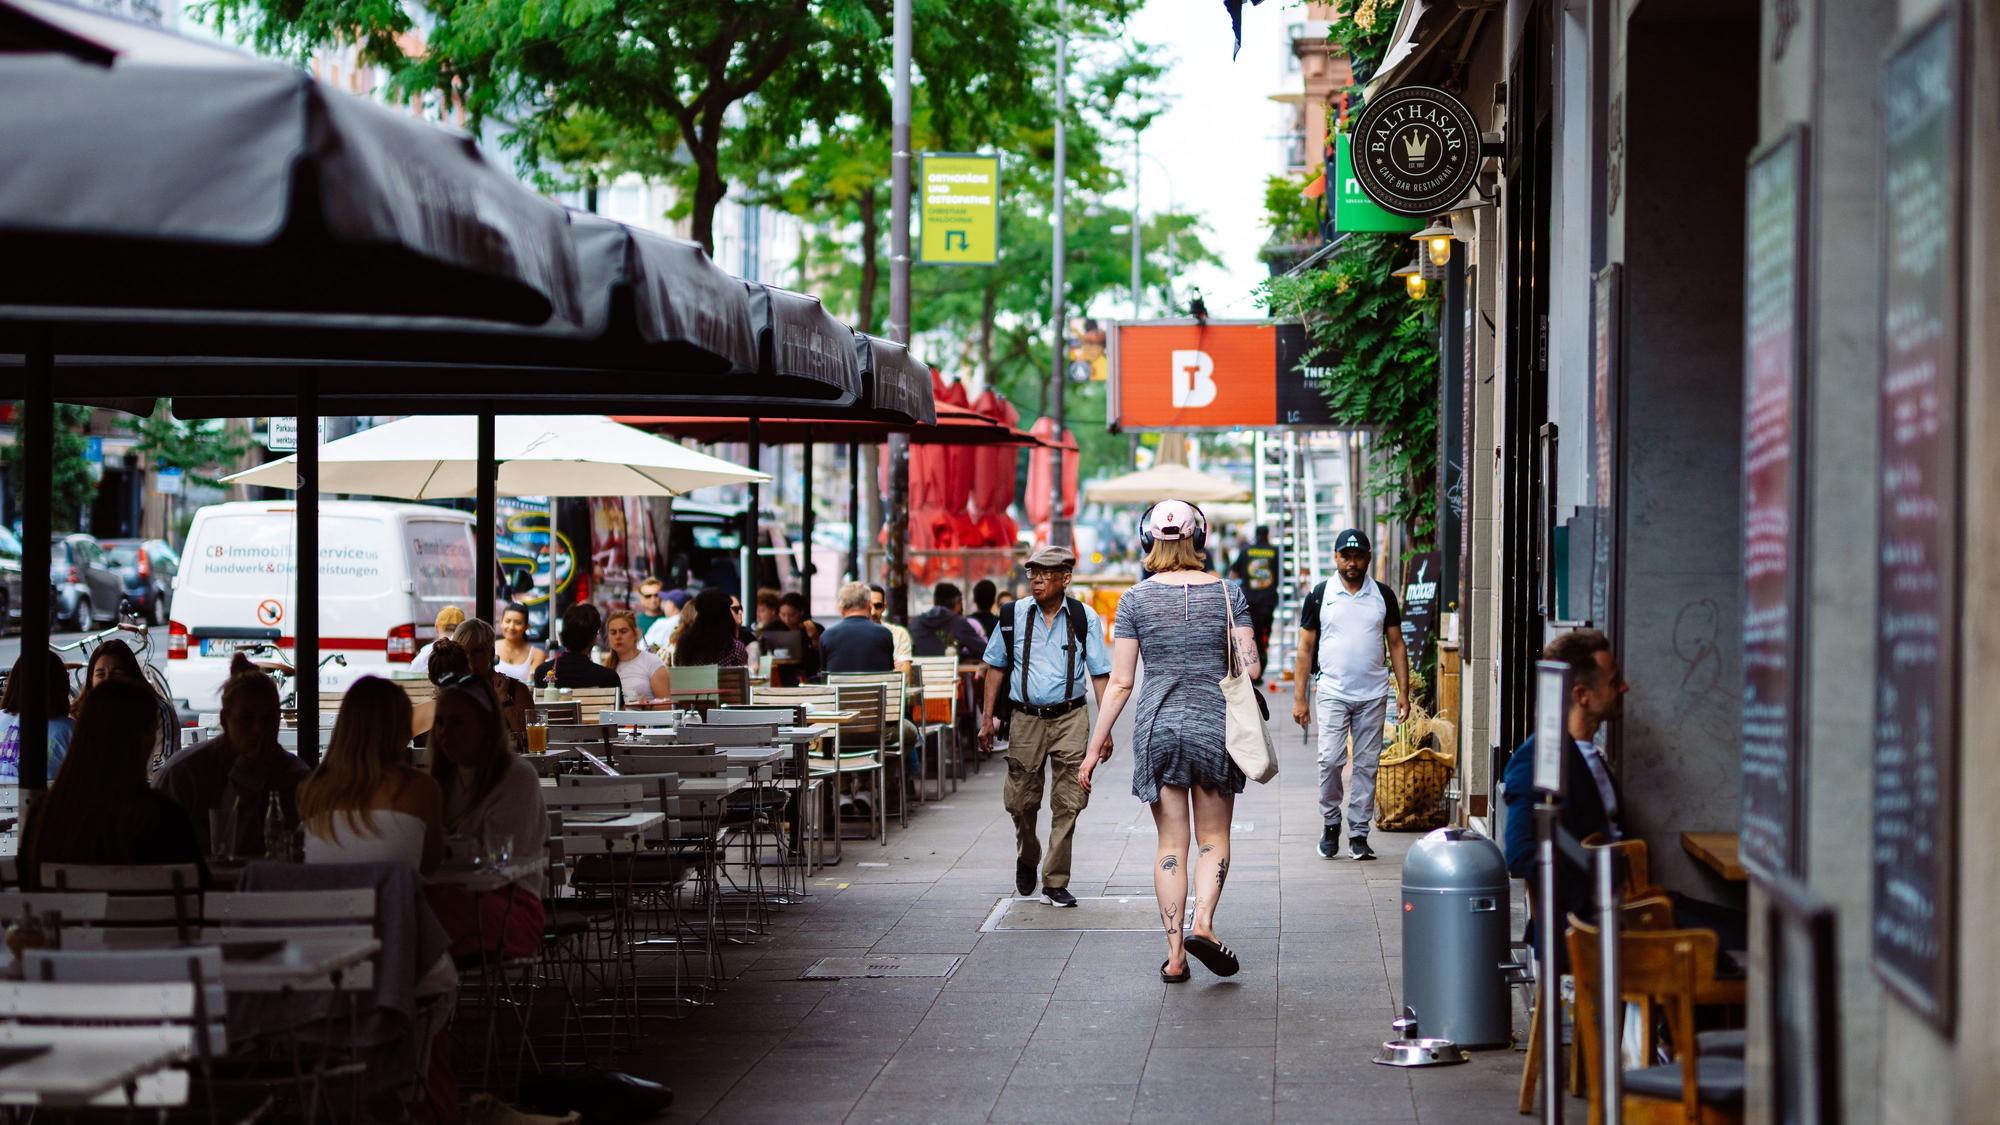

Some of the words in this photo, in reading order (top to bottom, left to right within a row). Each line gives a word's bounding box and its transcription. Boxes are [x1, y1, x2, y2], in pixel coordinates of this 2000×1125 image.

[1372, 105, 1461, 152] BALTHASAR
[1395, 180, 1411, 191] BAR
[1413, 164, 1454, 192] RESTAURANT
